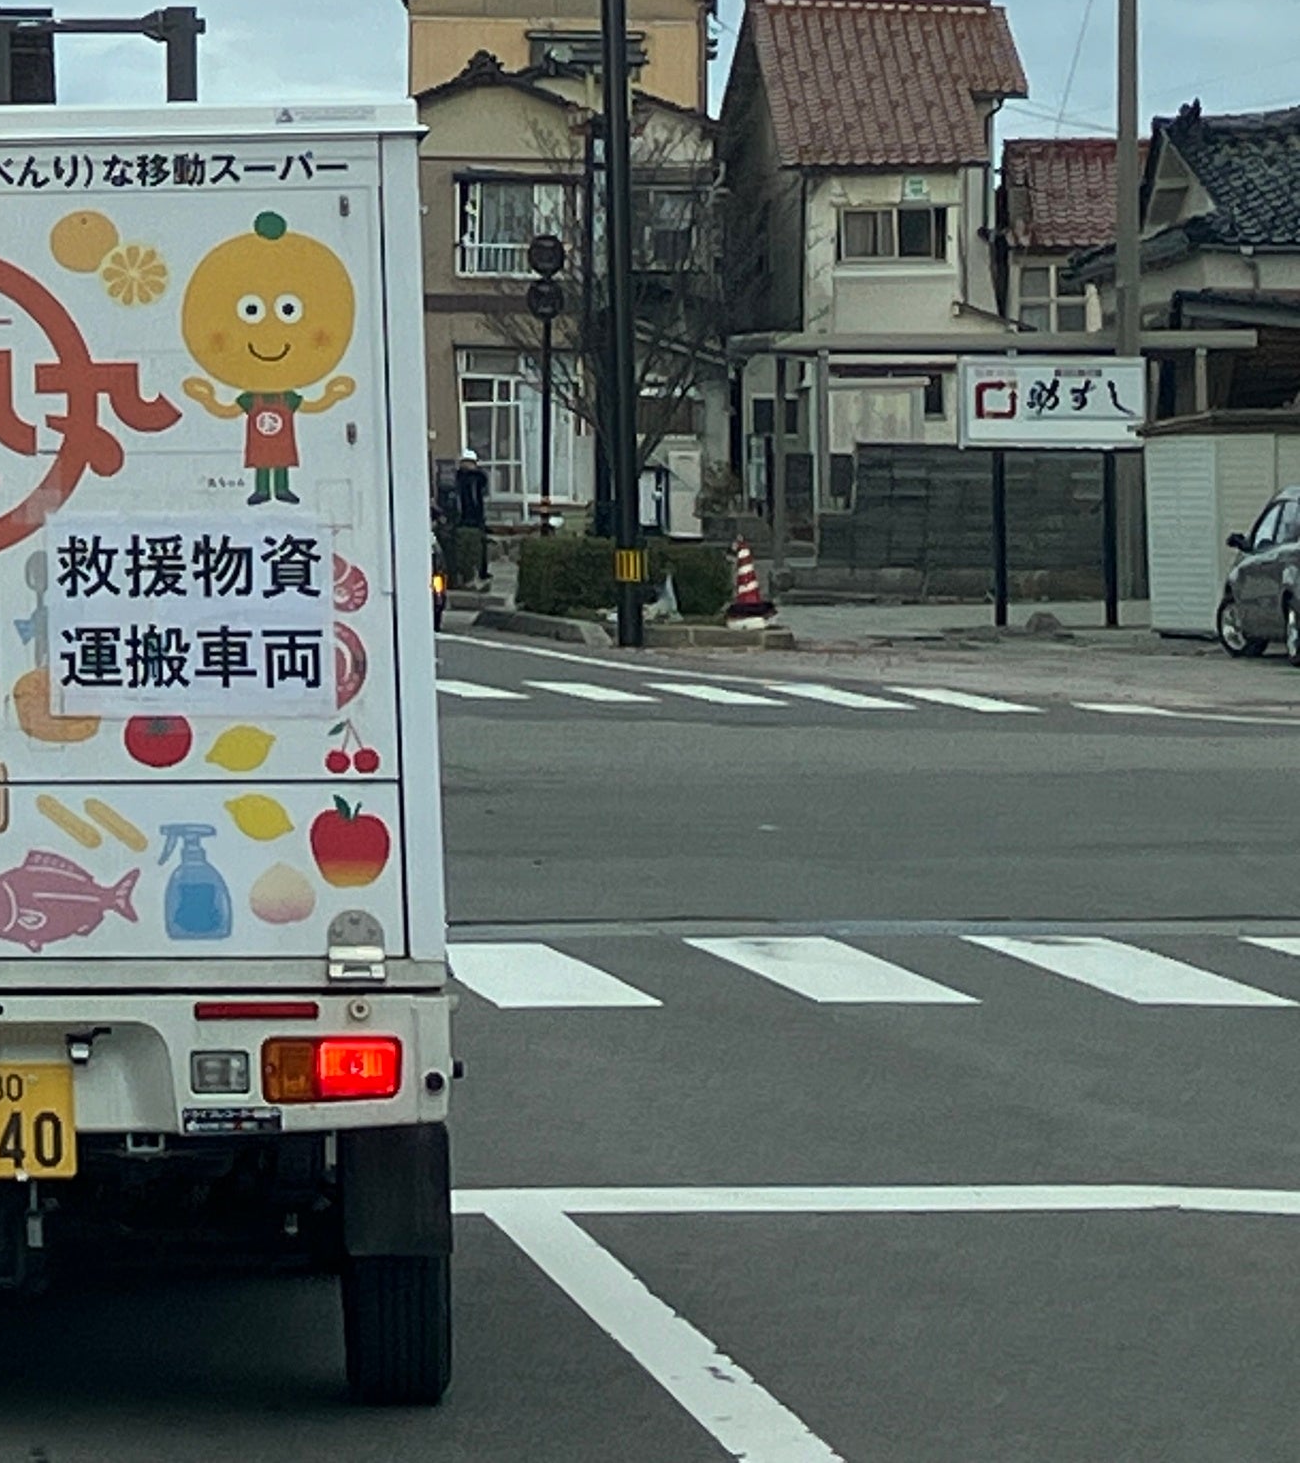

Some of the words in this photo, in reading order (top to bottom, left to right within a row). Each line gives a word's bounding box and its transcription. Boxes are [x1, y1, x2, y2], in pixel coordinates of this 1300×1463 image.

[56, 534, 322, 599] 救援物資
[59, 624, 324, 689] 運搬車両
